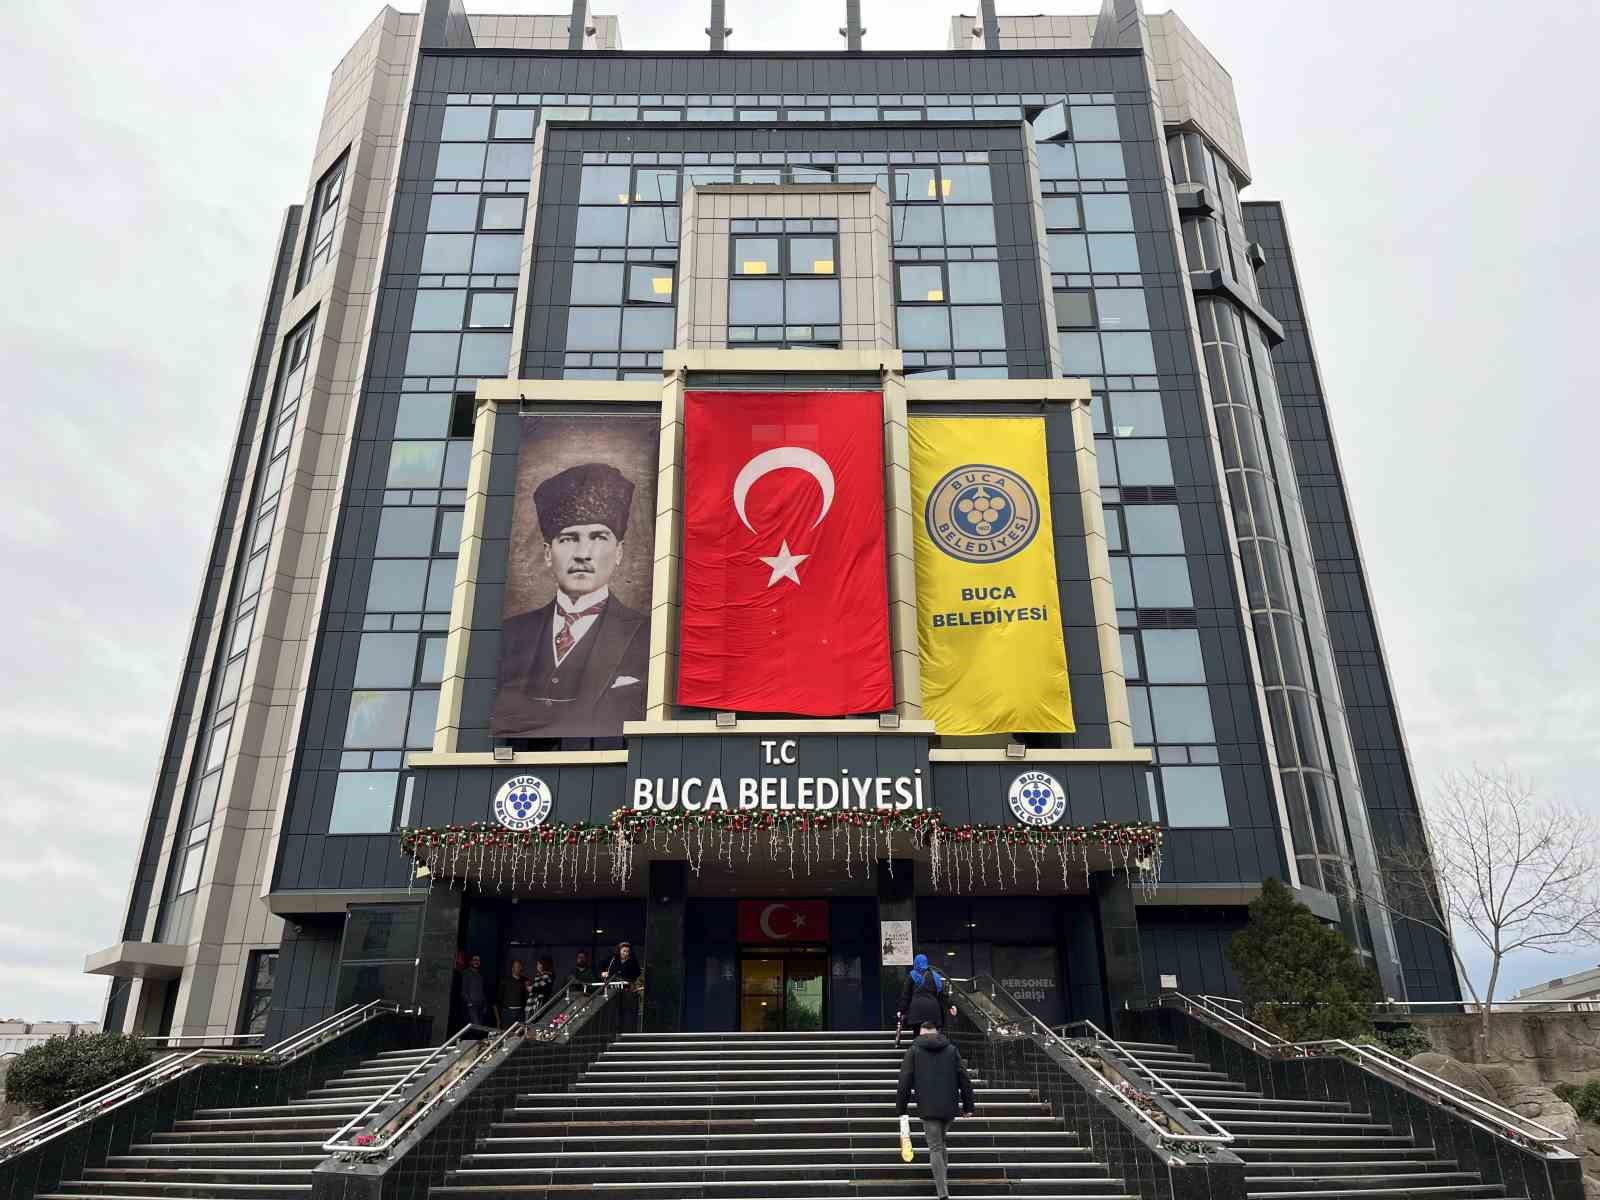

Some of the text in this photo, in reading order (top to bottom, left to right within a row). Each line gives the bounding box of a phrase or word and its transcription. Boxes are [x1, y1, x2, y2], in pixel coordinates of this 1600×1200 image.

[951, 474, 1006, 490] BUCA
[962, 587, 1016, 601] BUCA
[932, 605, 1048, 627] BELEDİYESİ
[761, 740, 797, 764] T.C
[508, 778, 541, 788] BUCA
[1019, 774, 1051, 785] BUCA
[633, 769, 924, 811] BUCA BELEDİYESİ
[1001, 978, 1055, 988] PERSONEL
